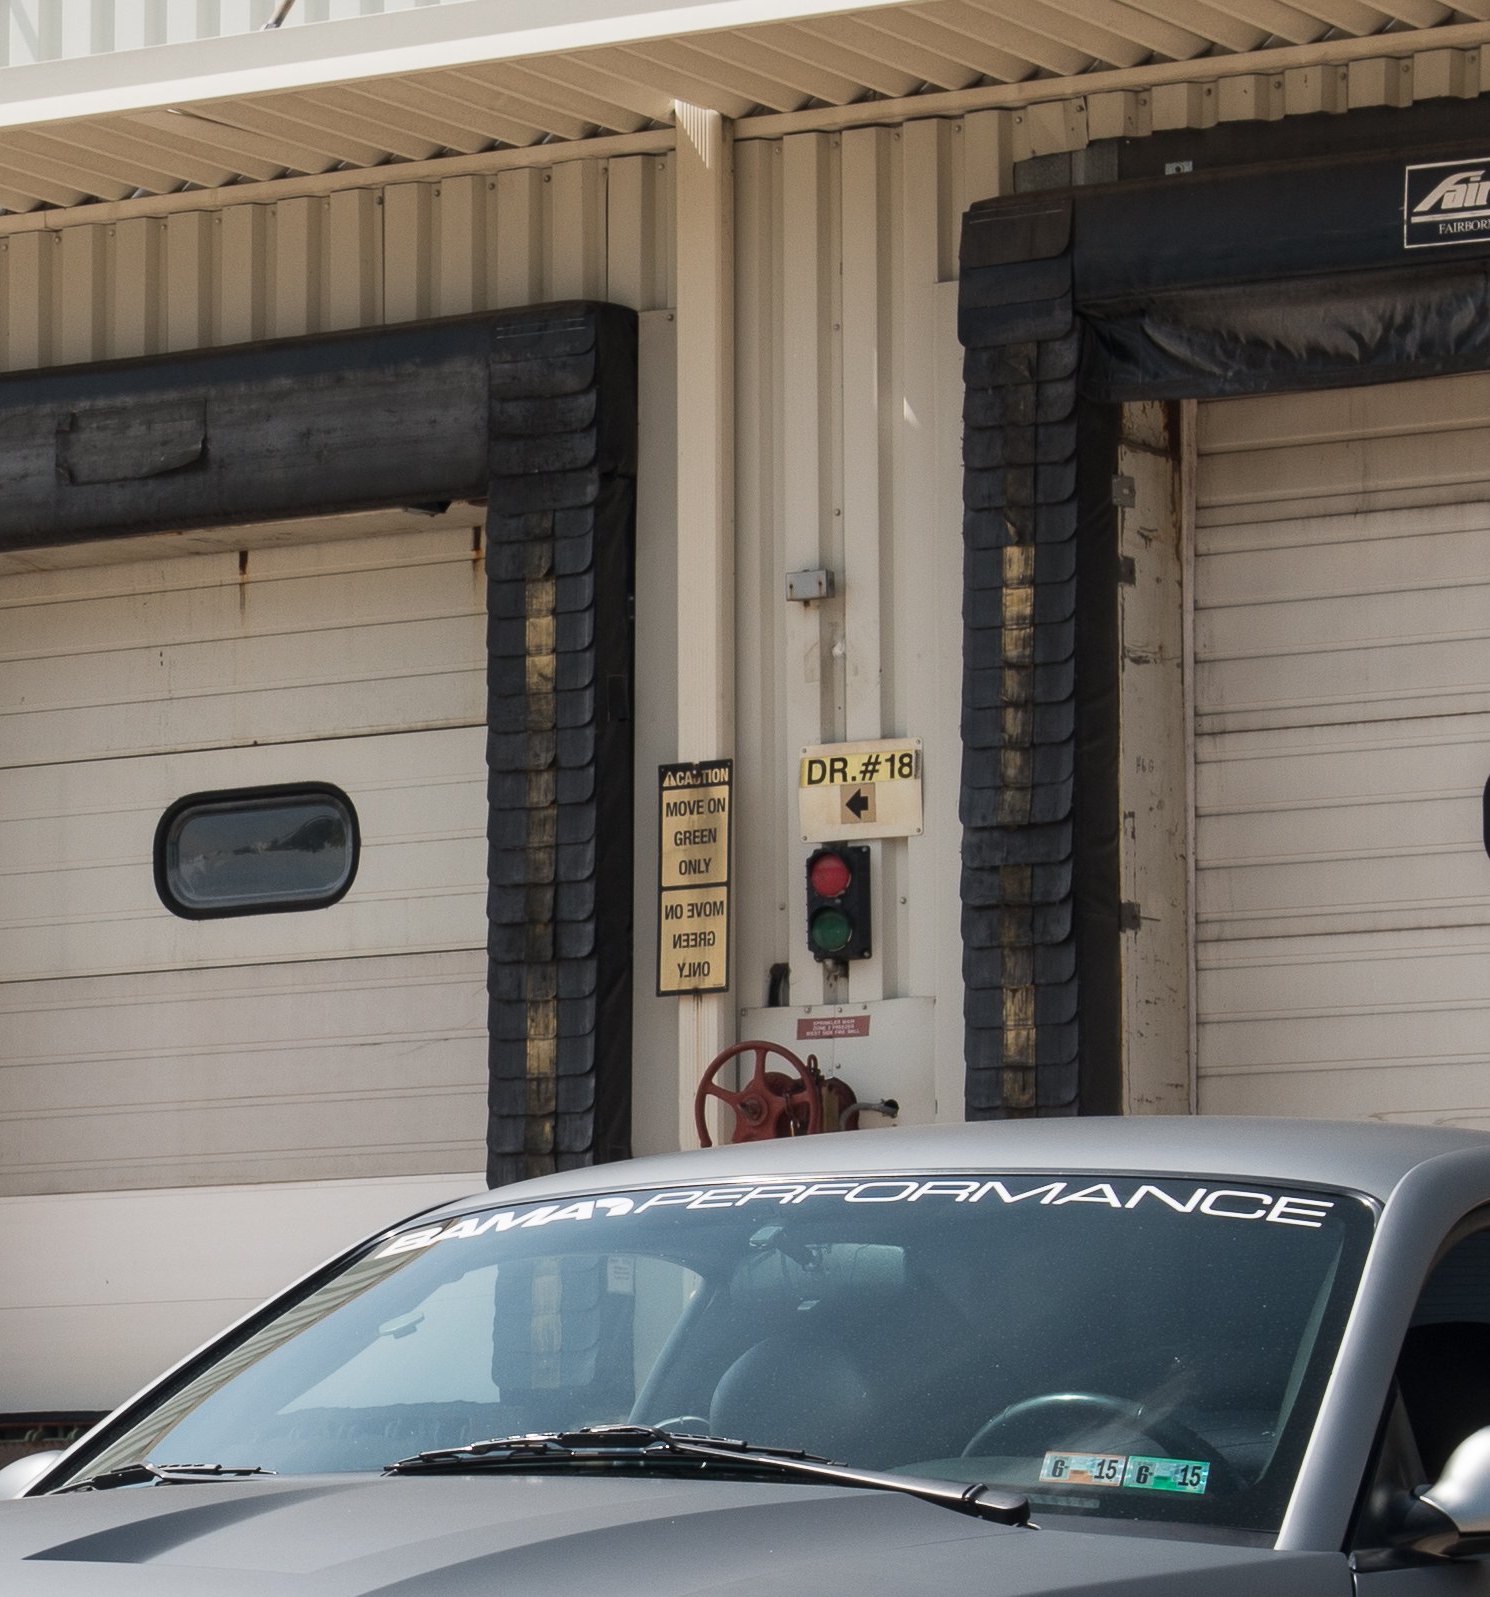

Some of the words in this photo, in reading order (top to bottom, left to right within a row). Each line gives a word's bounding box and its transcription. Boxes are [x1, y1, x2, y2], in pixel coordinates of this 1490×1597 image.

[807, 753, 913, 785] DR.#18
[666, 800, 704, 817] MOVE
[707, 797, 726, 814] ON
[674, 828, 717, 847] GREEN
[678, 858, 712, 875] ONLY
[634, 1182, 1334, 1228] PERFORMANCE
[1094, 1458, 1119, 1480] 15
[1177, 1464, 1202, 1487] 15
